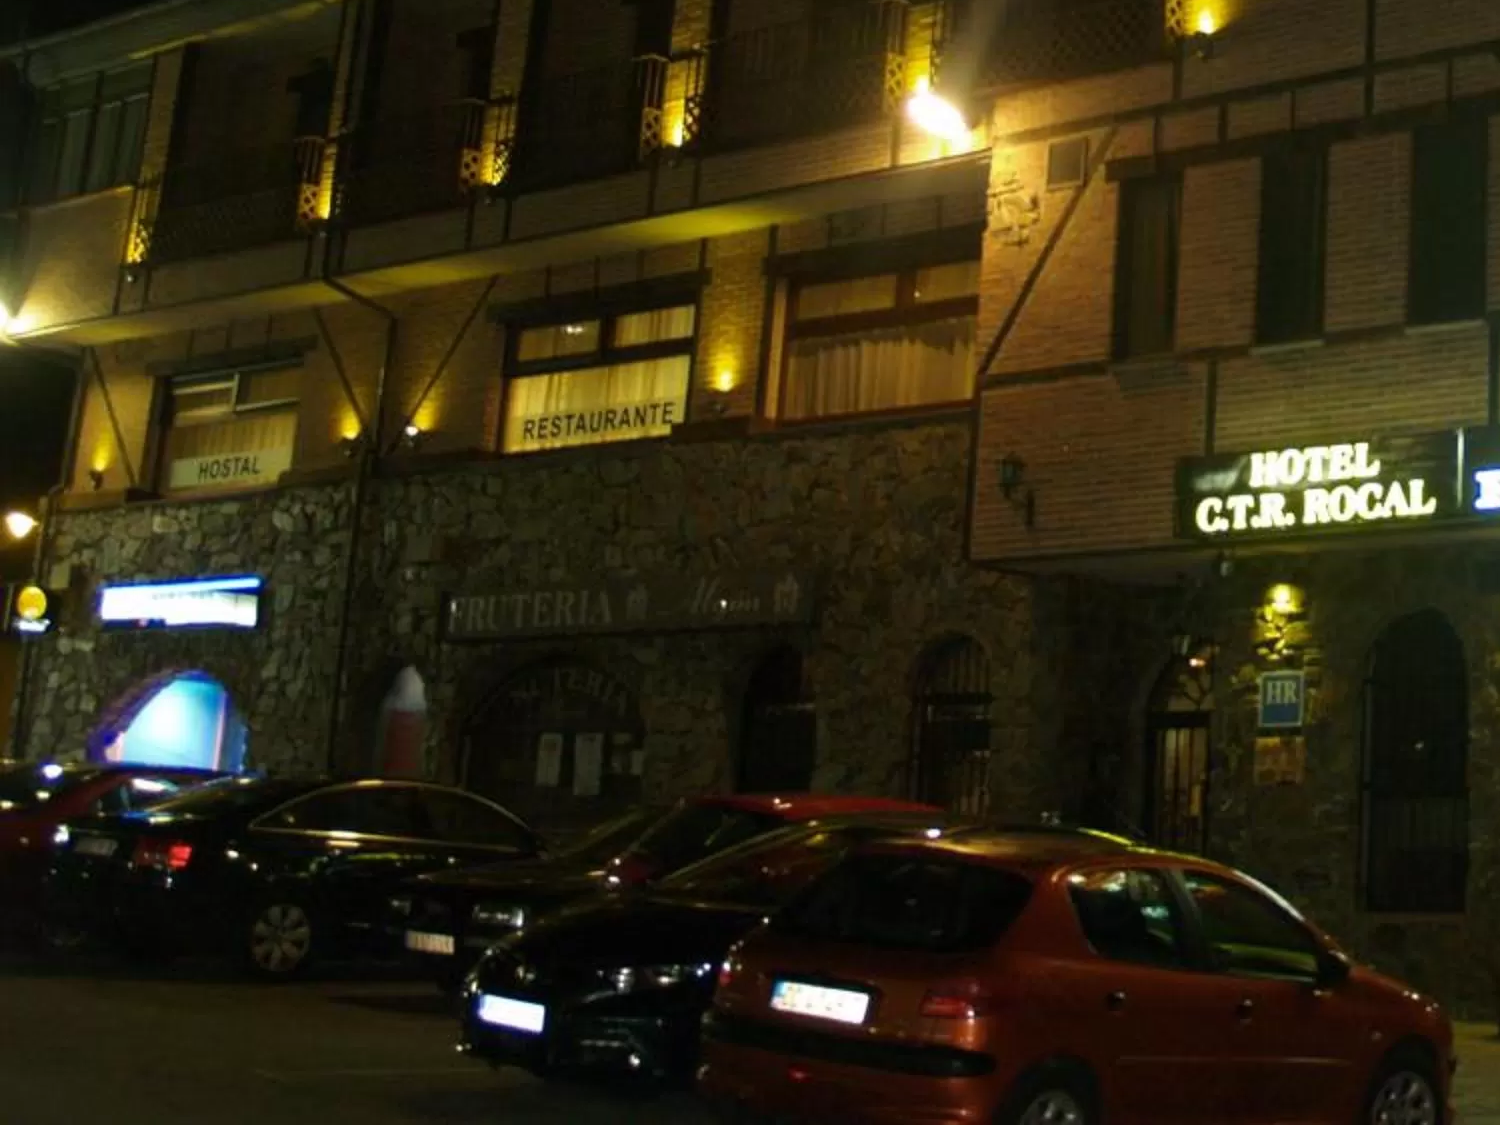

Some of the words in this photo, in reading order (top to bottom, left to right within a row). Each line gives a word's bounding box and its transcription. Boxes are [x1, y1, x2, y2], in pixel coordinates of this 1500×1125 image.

[523, 402, 676, 440] RESTAURANTE
[198, 456, 262, 480] HOSTAL
[1248, 442, 1381, 488] HOTEL
[1195, 491, 1296, 533] C.T.R.
[1302, 478, 1437, 525] ROCAL
